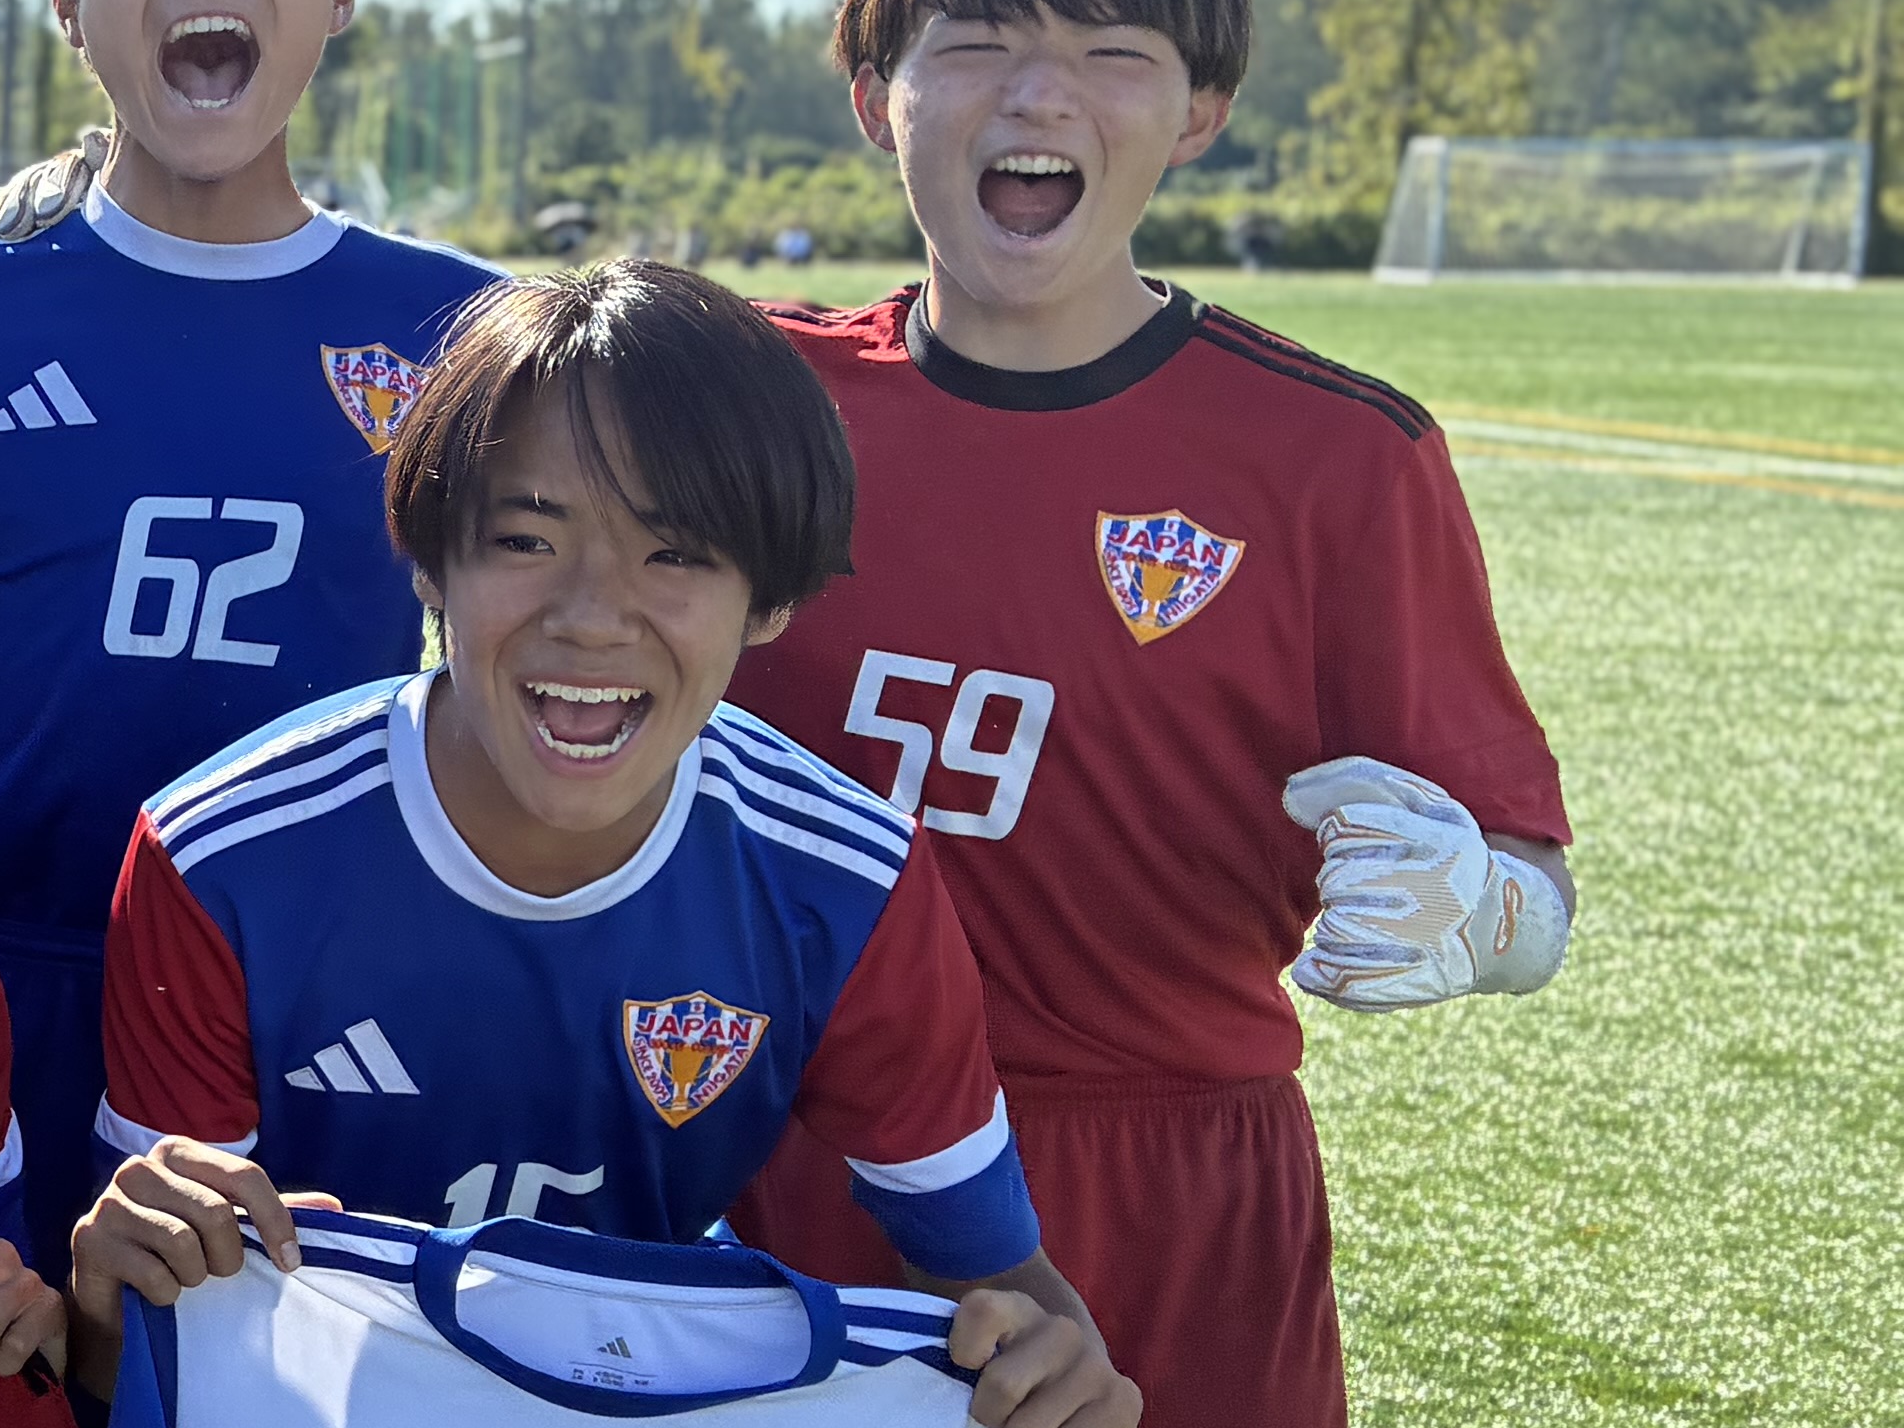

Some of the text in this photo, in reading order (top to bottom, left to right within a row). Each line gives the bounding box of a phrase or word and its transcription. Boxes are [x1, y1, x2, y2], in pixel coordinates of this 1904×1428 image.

[1107, 525, 1226, 567] JAPAN
[104, 497, 304, 667] 62
[844, 649, 1055, 841] 59
[635, 1014, 752, 1041] JAPAN
[693, 1048, 749, 1104] NIIGATA
